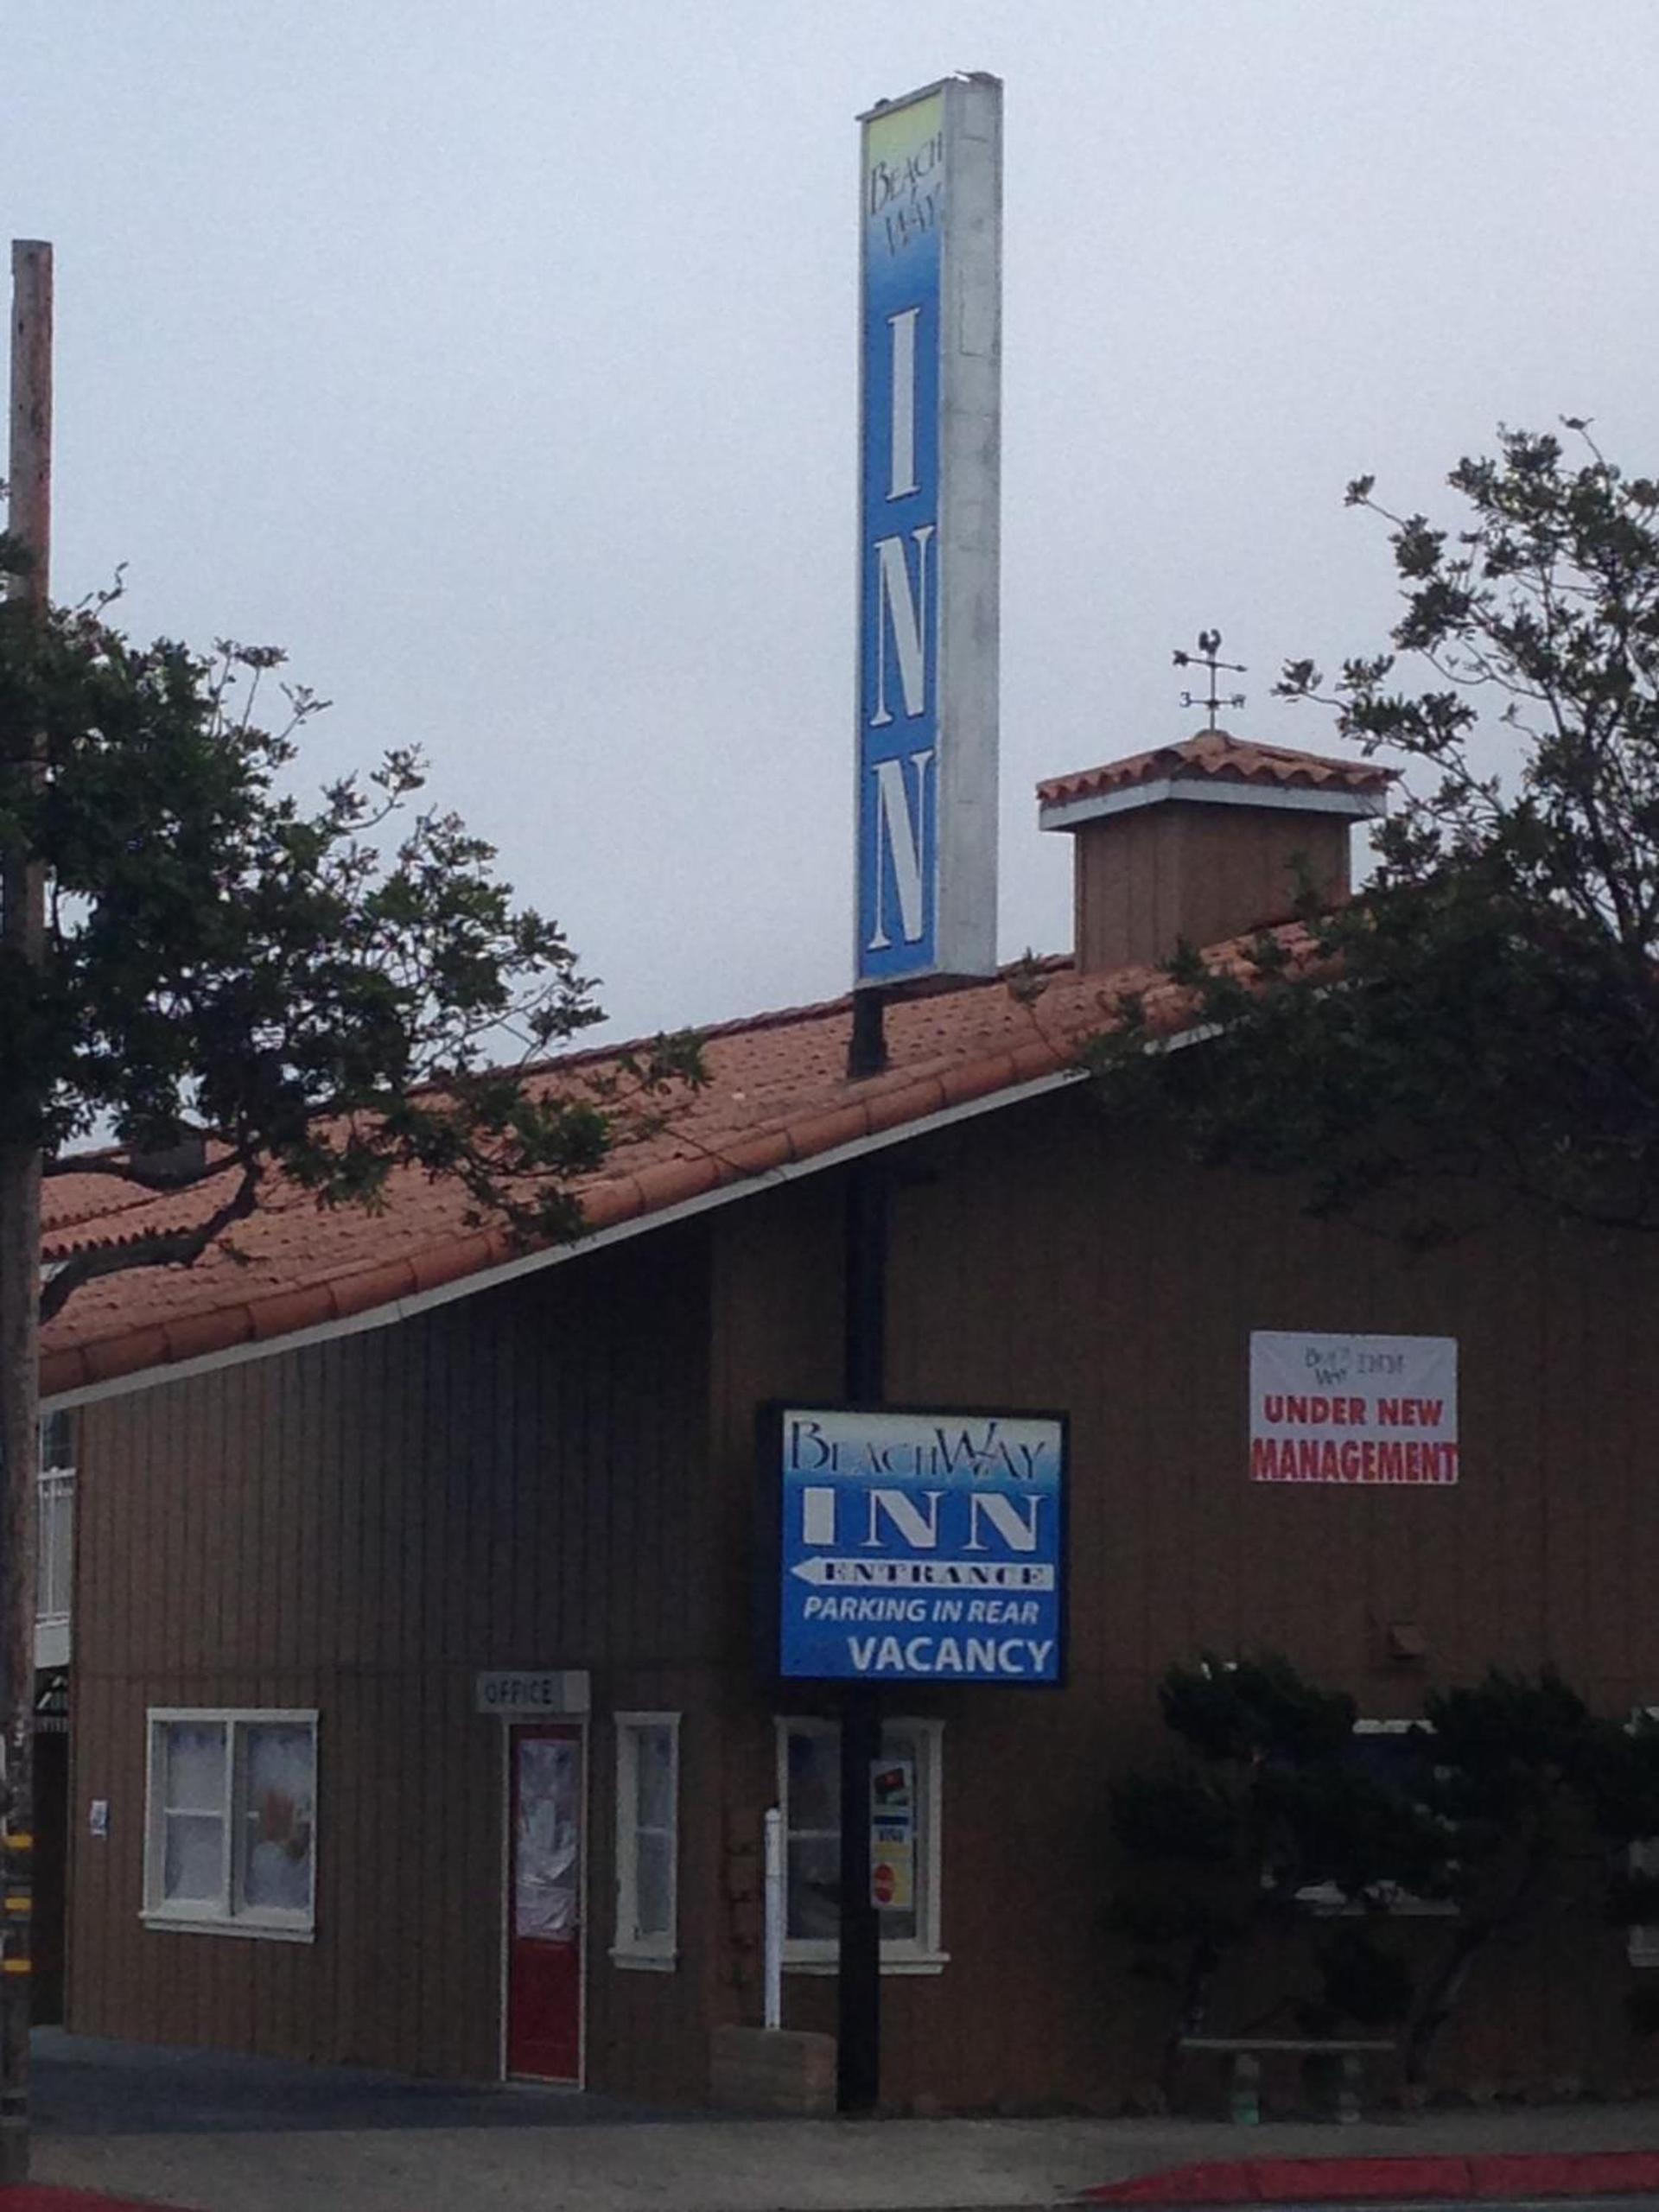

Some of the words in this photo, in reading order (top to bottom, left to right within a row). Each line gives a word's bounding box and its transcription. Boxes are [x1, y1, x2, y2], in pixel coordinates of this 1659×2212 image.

[867, 307, 937, 952] INN
[1263, 1395, 1367, 1426] UNDER
[1376, 1397, 1444, 1427] NEW
[1252, 1438, 1459, 1481] MANAGEMENT
[802, 1486, 1048, 1552] INN
[824, 1562, 1046, 1585] ENTRANCE
[803, 1596, 925, 1622] PARKING
[931, 1599, 963, 1623] IN
[967, 1600, 1040, 1625] REAR
[846, 1635, 1054, 1674] VACANCY
